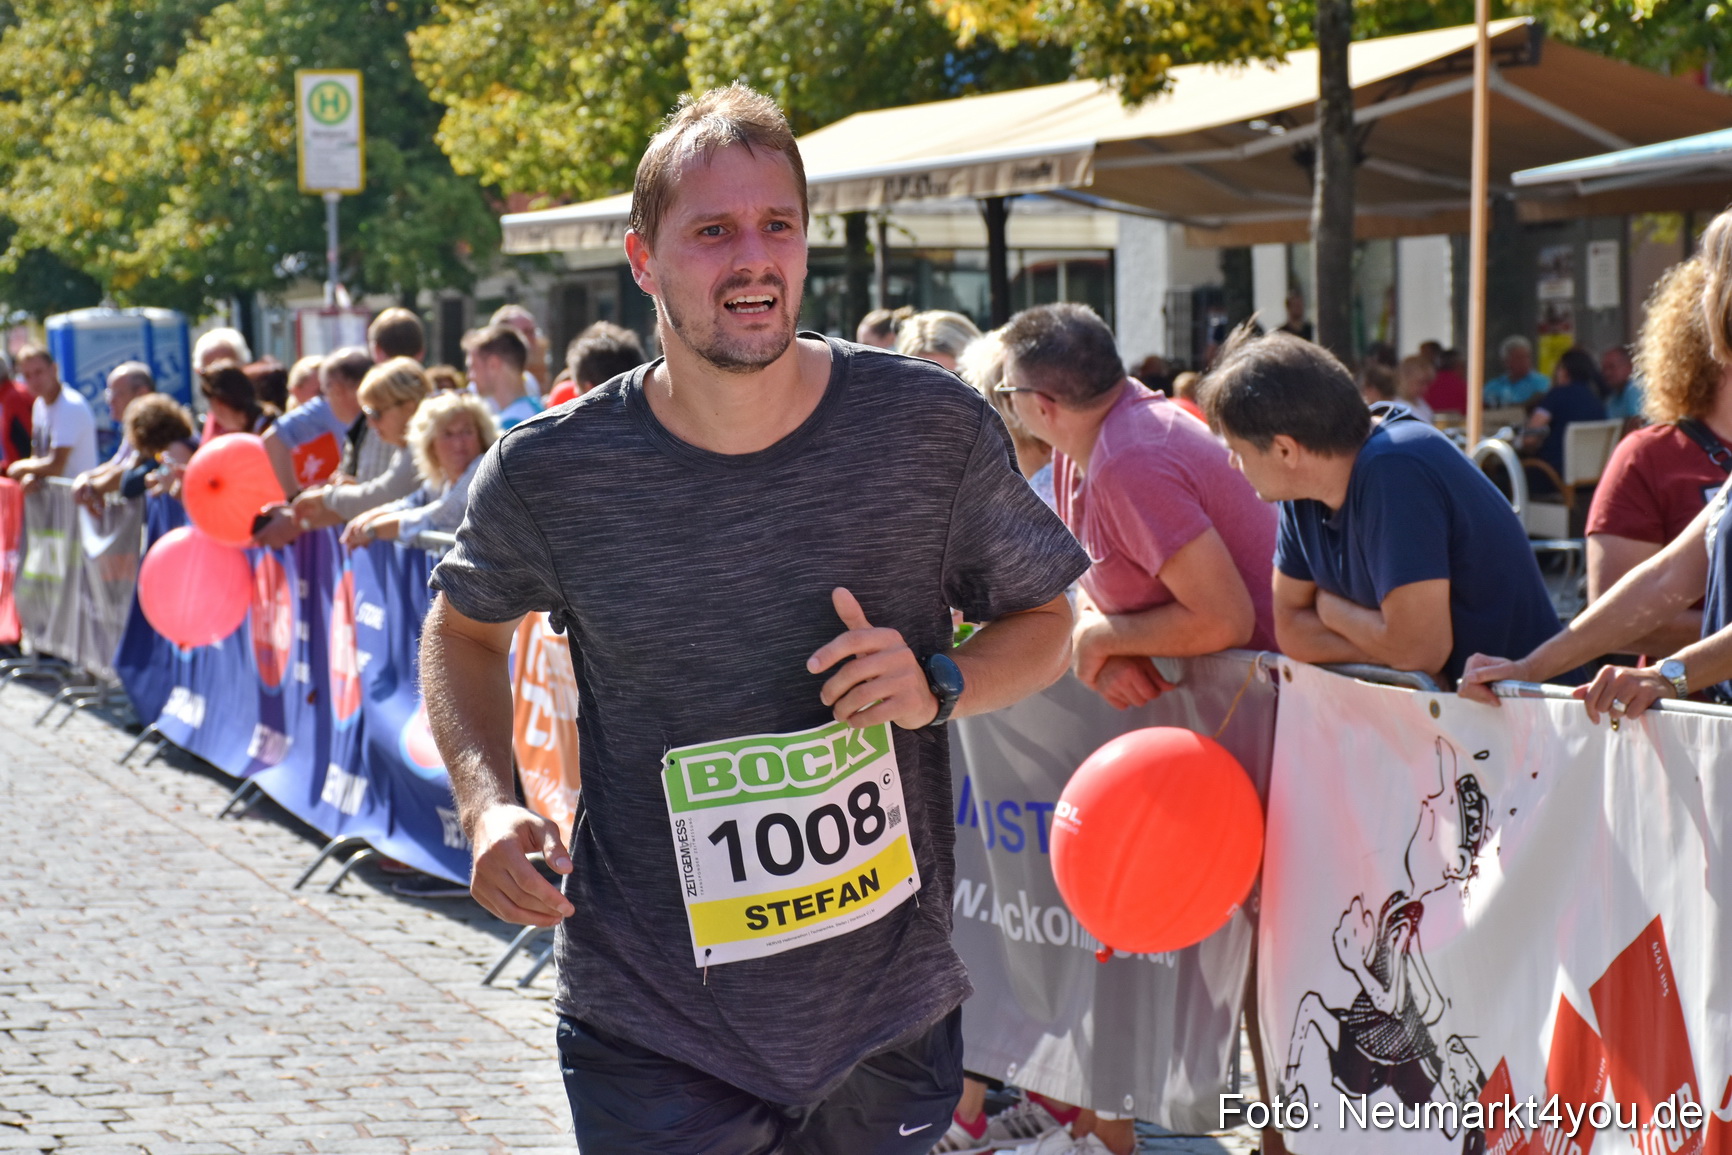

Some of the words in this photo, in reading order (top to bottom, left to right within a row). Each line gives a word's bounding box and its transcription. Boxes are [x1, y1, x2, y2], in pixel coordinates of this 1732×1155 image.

[680, 727, 877, 802] BOCK
[707, 780, 887, 883] 1008
[745, 868, 881, 931] STEFAN
